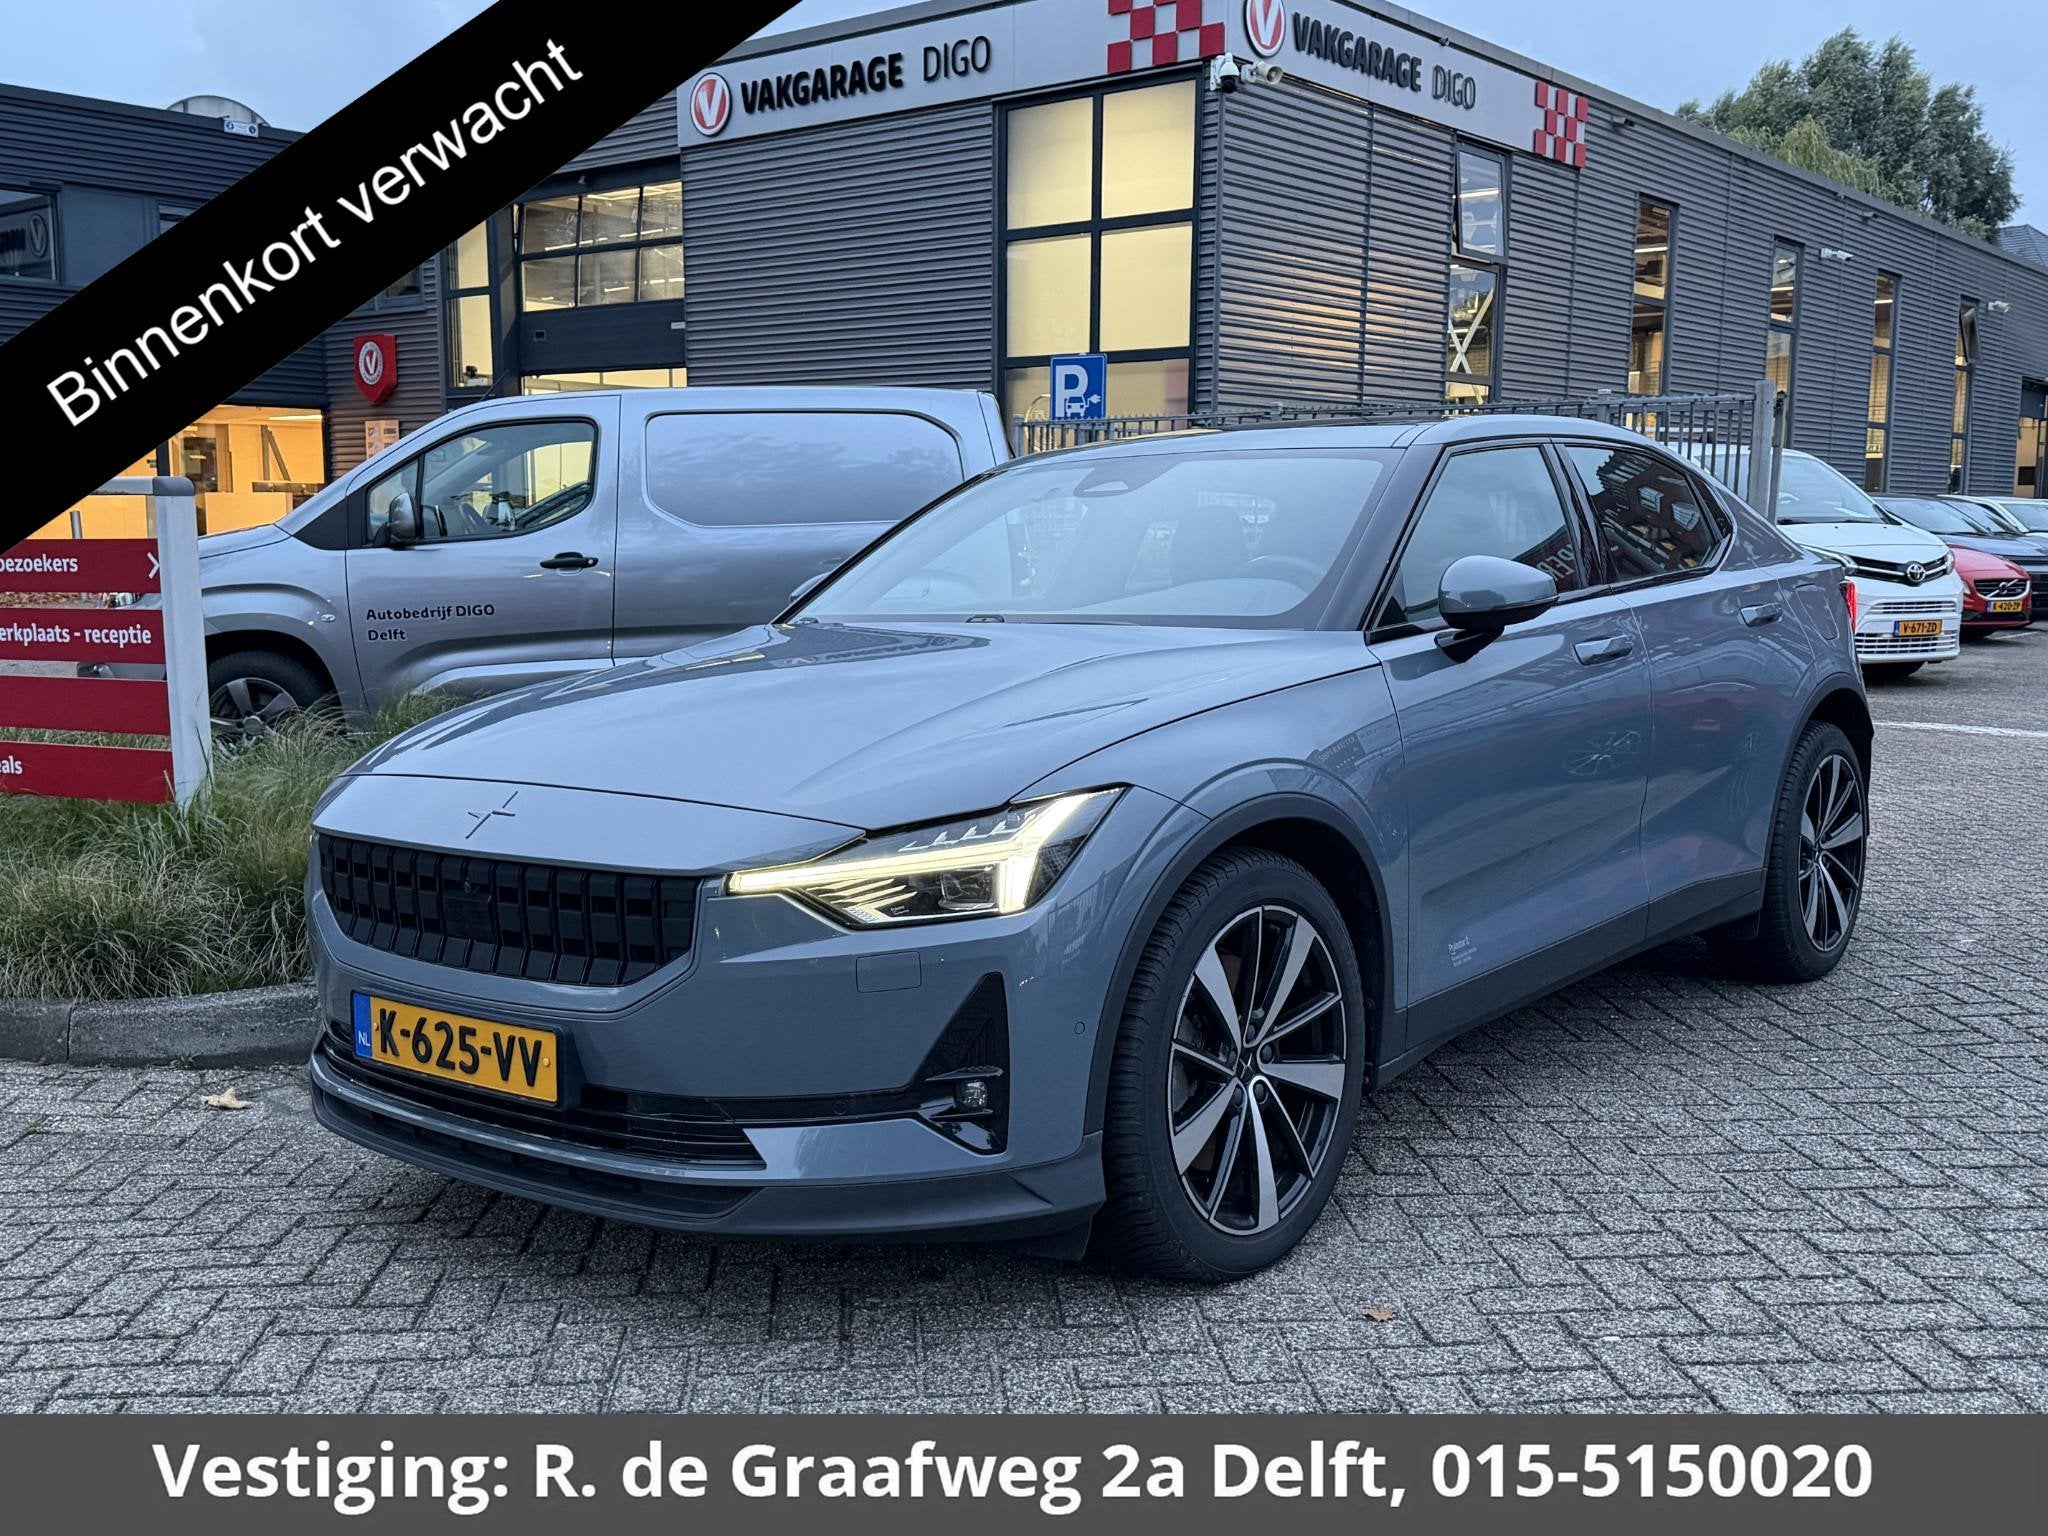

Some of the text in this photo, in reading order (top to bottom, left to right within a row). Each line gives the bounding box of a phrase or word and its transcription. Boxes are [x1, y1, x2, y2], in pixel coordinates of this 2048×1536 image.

[1292, 11, 1477, 110] VAKGARAGE DIGO
[740, 35, 992, 114] VAKGARAGE DIGO
[1055, 364, 1089, 418] P
[366, 604, 495, 621] Autobedrijf DIGO
[0, 622, 71, 646] erkplaats
[84, 624, 152, 648] receptie
[367, 629, 407, 641] Delft
[1903, 621, 1938, 634] V-671-ZD
[0, 755, 23, 775] als
[358, 1008, 542, 1087] NL K-625-VV
